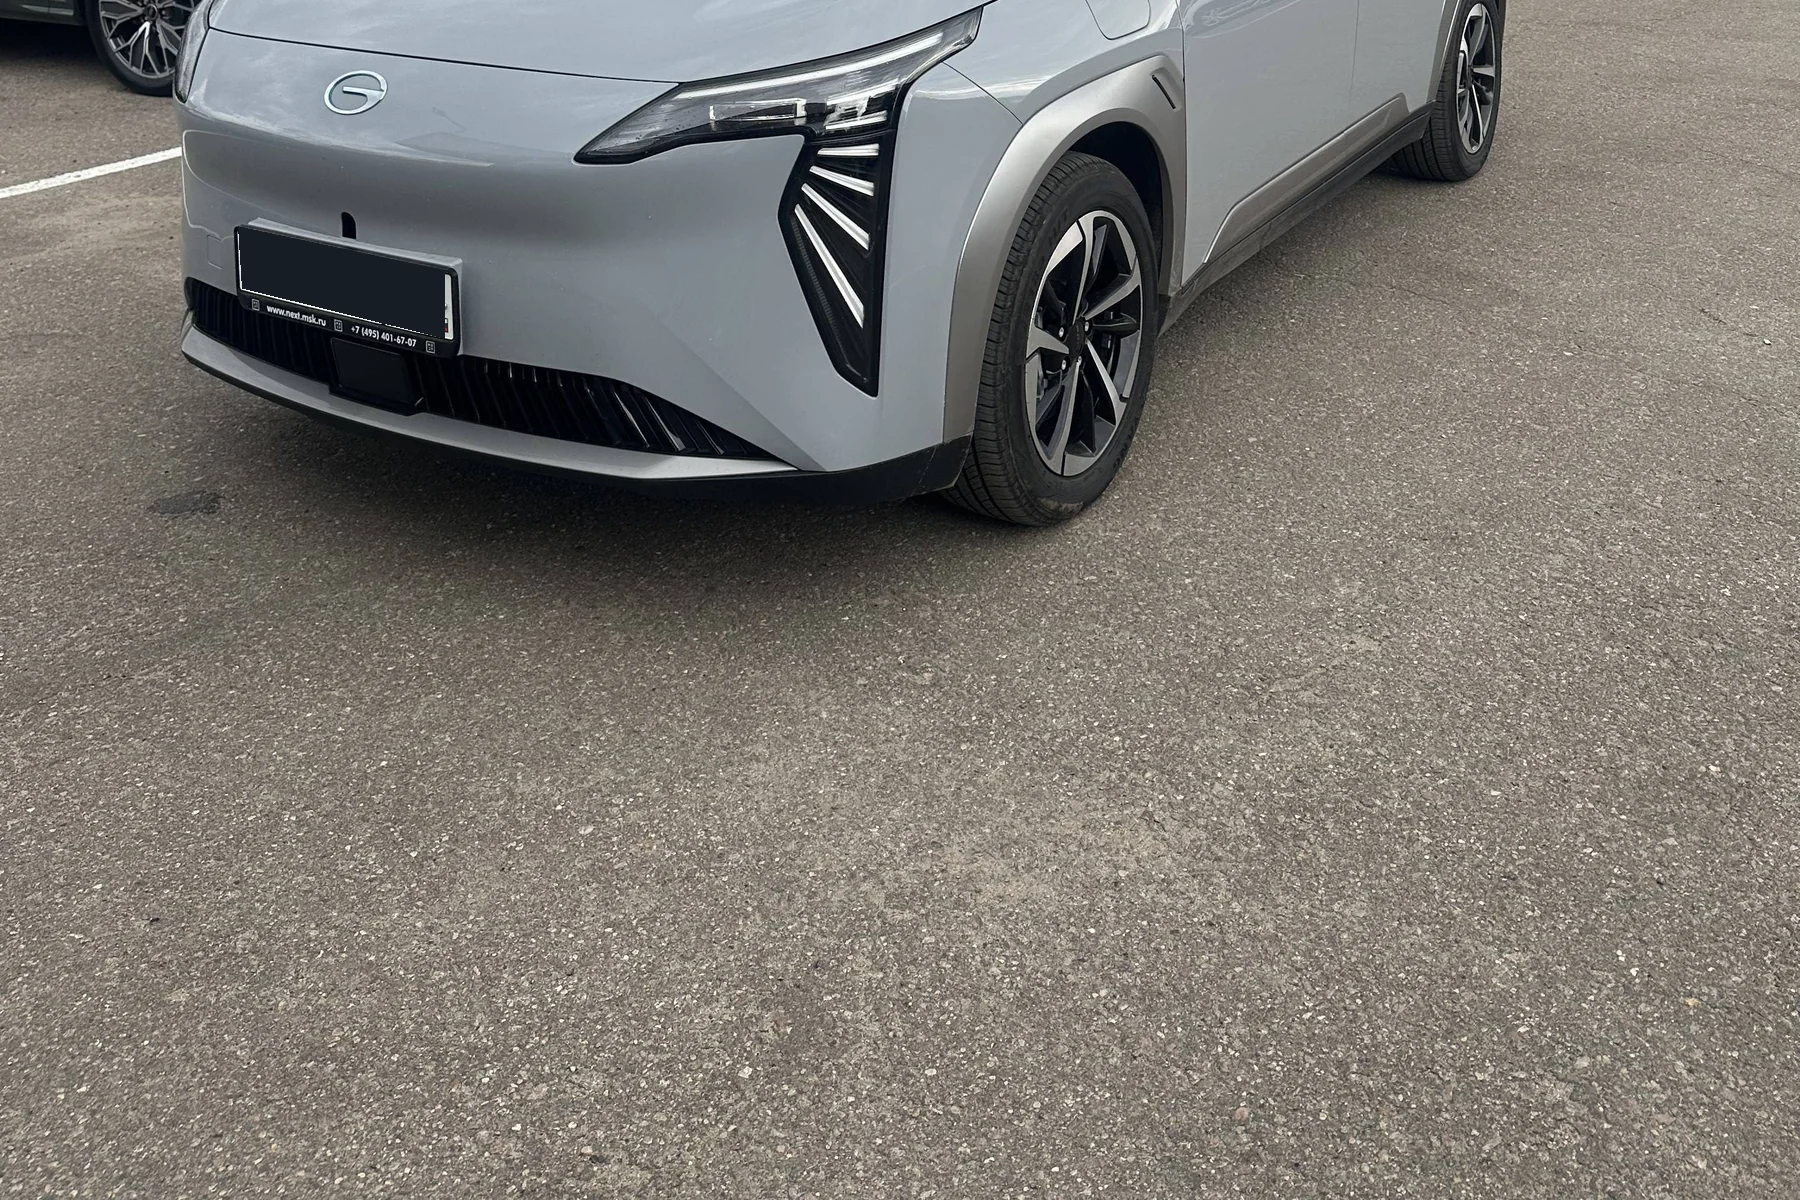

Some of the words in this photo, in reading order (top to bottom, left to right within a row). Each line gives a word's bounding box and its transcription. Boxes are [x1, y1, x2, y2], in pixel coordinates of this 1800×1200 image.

[266, 304, 327, 326] www.next.msk.ru
[351, 325, 360, 334] +7
[361, 327, 380, 341] (495)
[381, 333, 417, 347] 401-67-07
